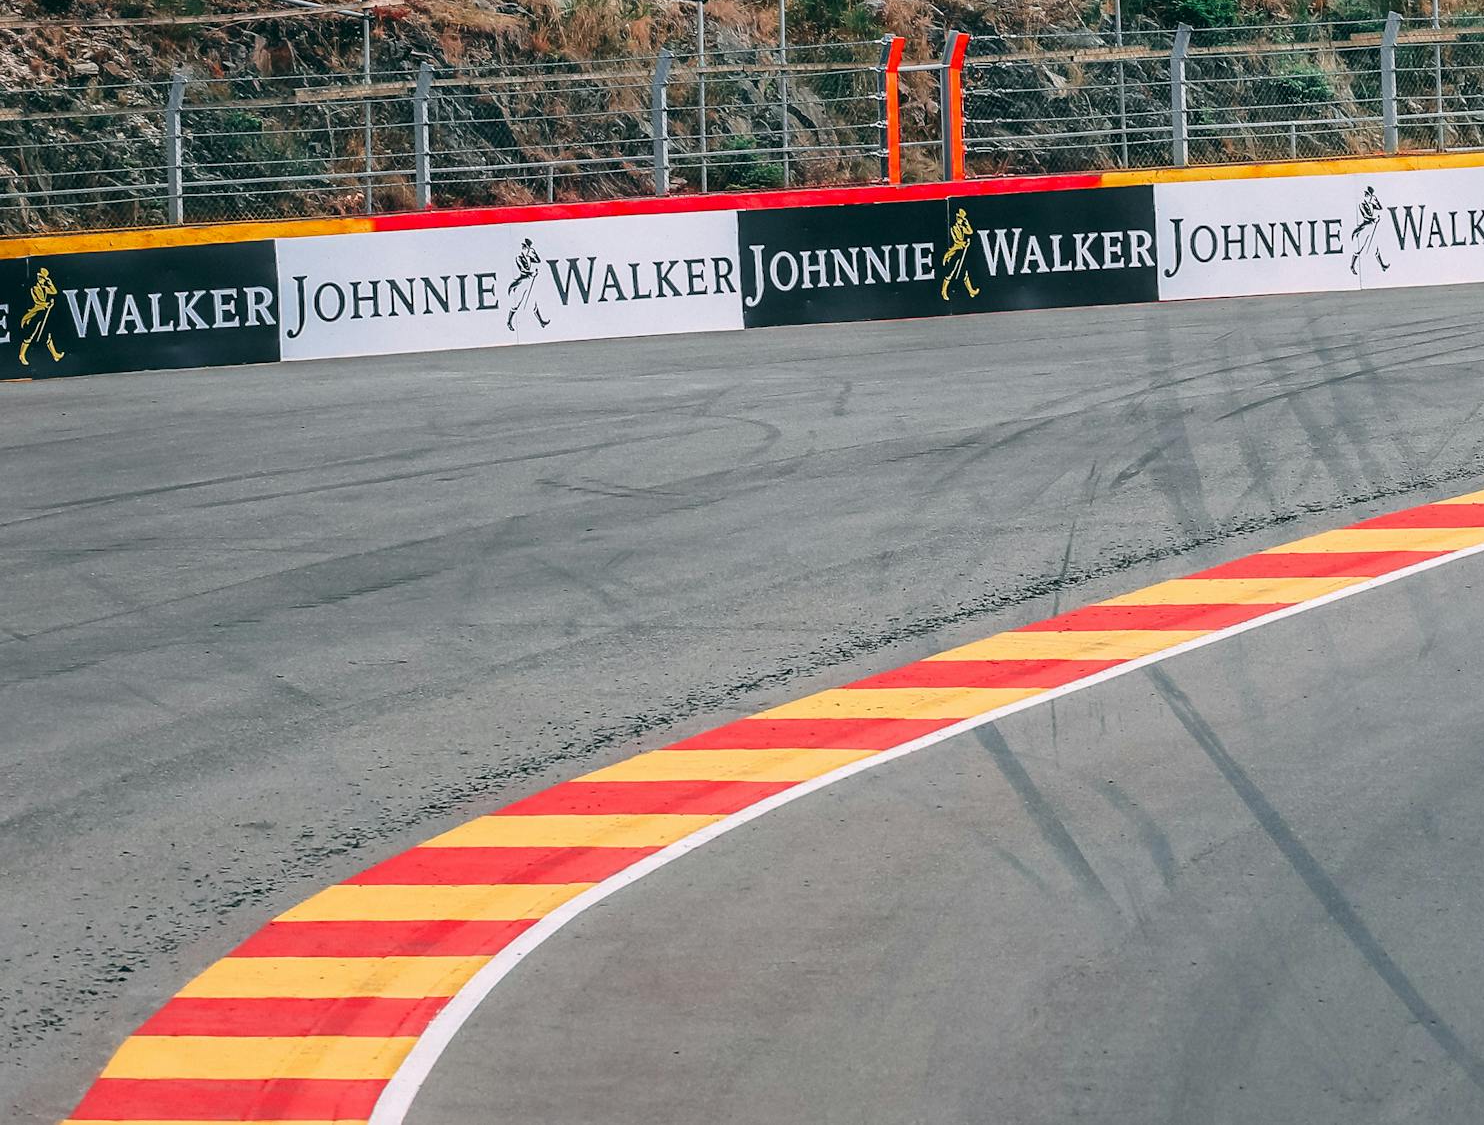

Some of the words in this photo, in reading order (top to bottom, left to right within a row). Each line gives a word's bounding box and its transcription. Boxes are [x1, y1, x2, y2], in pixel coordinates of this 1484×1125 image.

[745, 242, 936, 308] JOHNNIE
[977, 227, 1157, 277] WALKER
[1163, 218, 1344, 278] JOHNNIE
[62, 286, 277, 338] WALKER
[286, 272, 500, 340] JOHNNIE
[546, 256, 737, 307] WALKER
